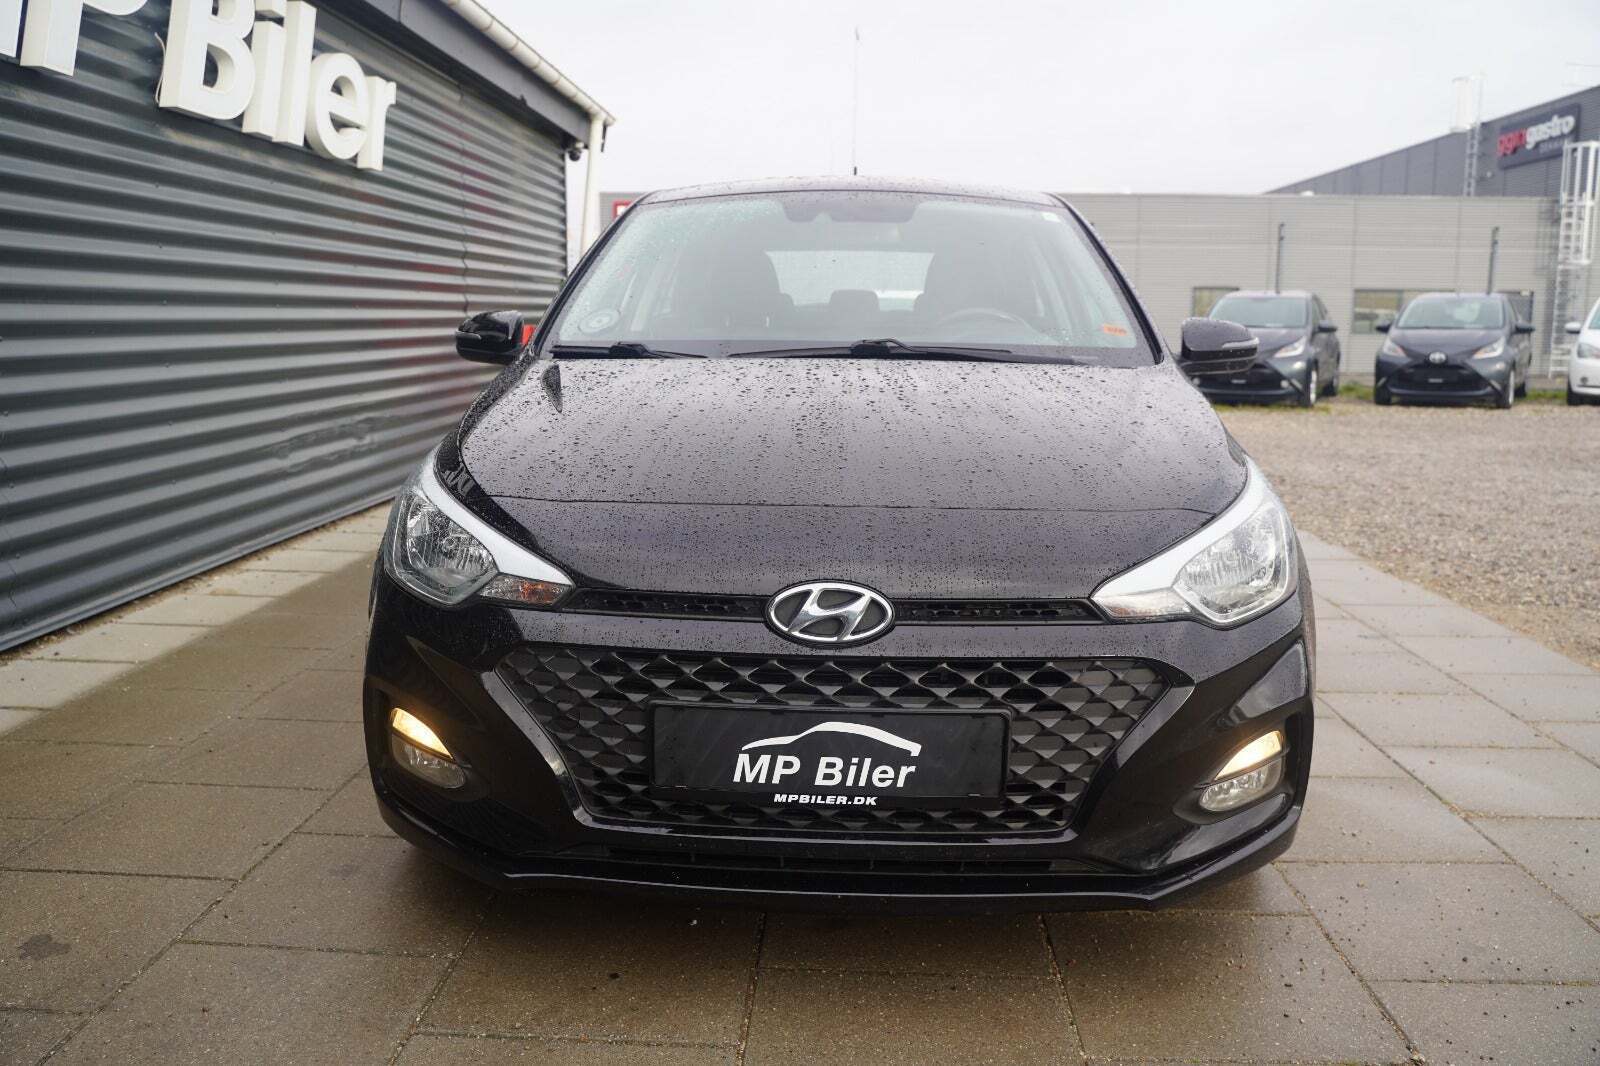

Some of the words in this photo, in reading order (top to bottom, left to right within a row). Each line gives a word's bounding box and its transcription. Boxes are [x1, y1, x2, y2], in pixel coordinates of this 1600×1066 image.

[159, 0, 396, 171] Biler
[733, 753, 801, 784] MP
[814, 756, 916, 788] Biler
[773, 793, 878, 806] MPBILER.DK
